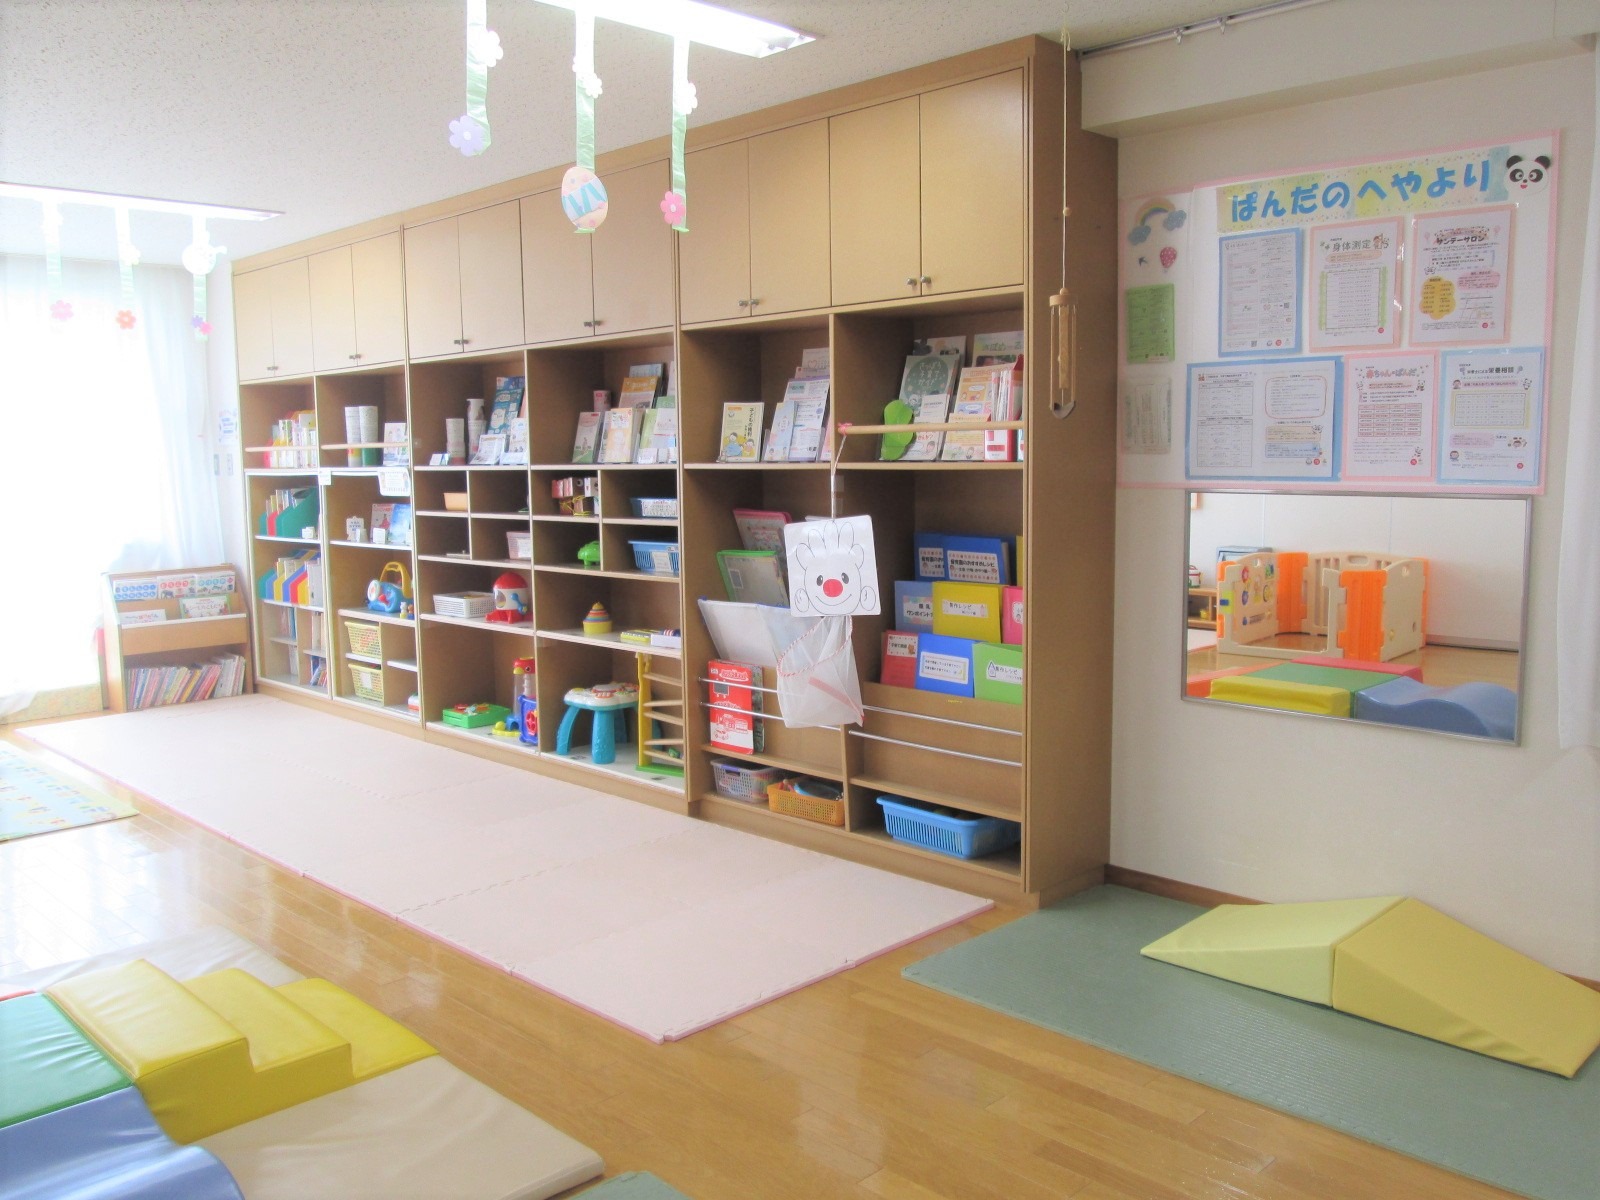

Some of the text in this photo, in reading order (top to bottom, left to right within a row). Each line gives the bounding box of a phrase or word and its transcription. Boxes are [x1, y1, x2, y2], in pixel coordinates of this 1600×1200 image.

[1231, 160, 1489, 222] ぱんだのへやより
[1332, 239, 1371, 252] 身体測定
